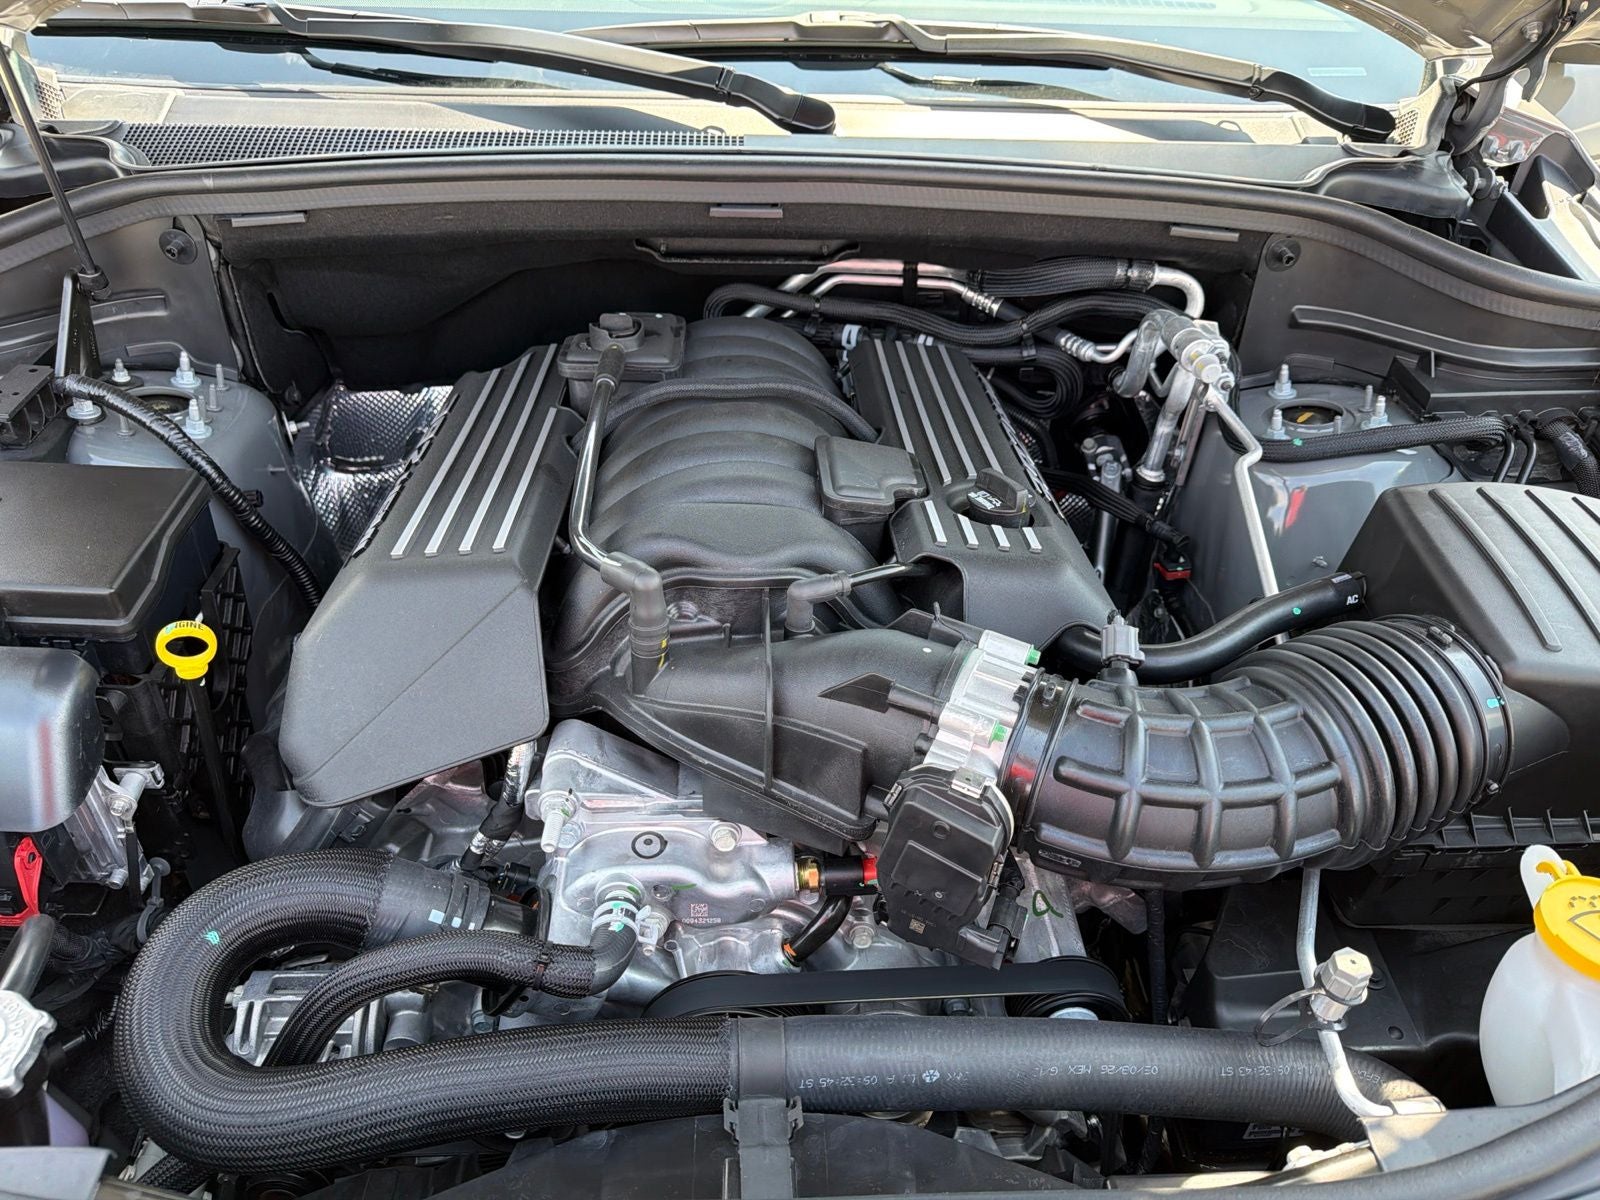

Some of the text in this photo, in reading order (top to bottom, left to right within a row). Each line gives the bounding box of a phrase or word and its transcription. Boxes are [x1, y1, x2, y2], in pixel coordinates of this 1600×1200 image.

[1346, 594, 1359, 606] AC
[1067, 1065, 1092, 1075] MEX
[1219, 1066, 1235, 1076] ST
[798, 1078, 815, 1089] ST
